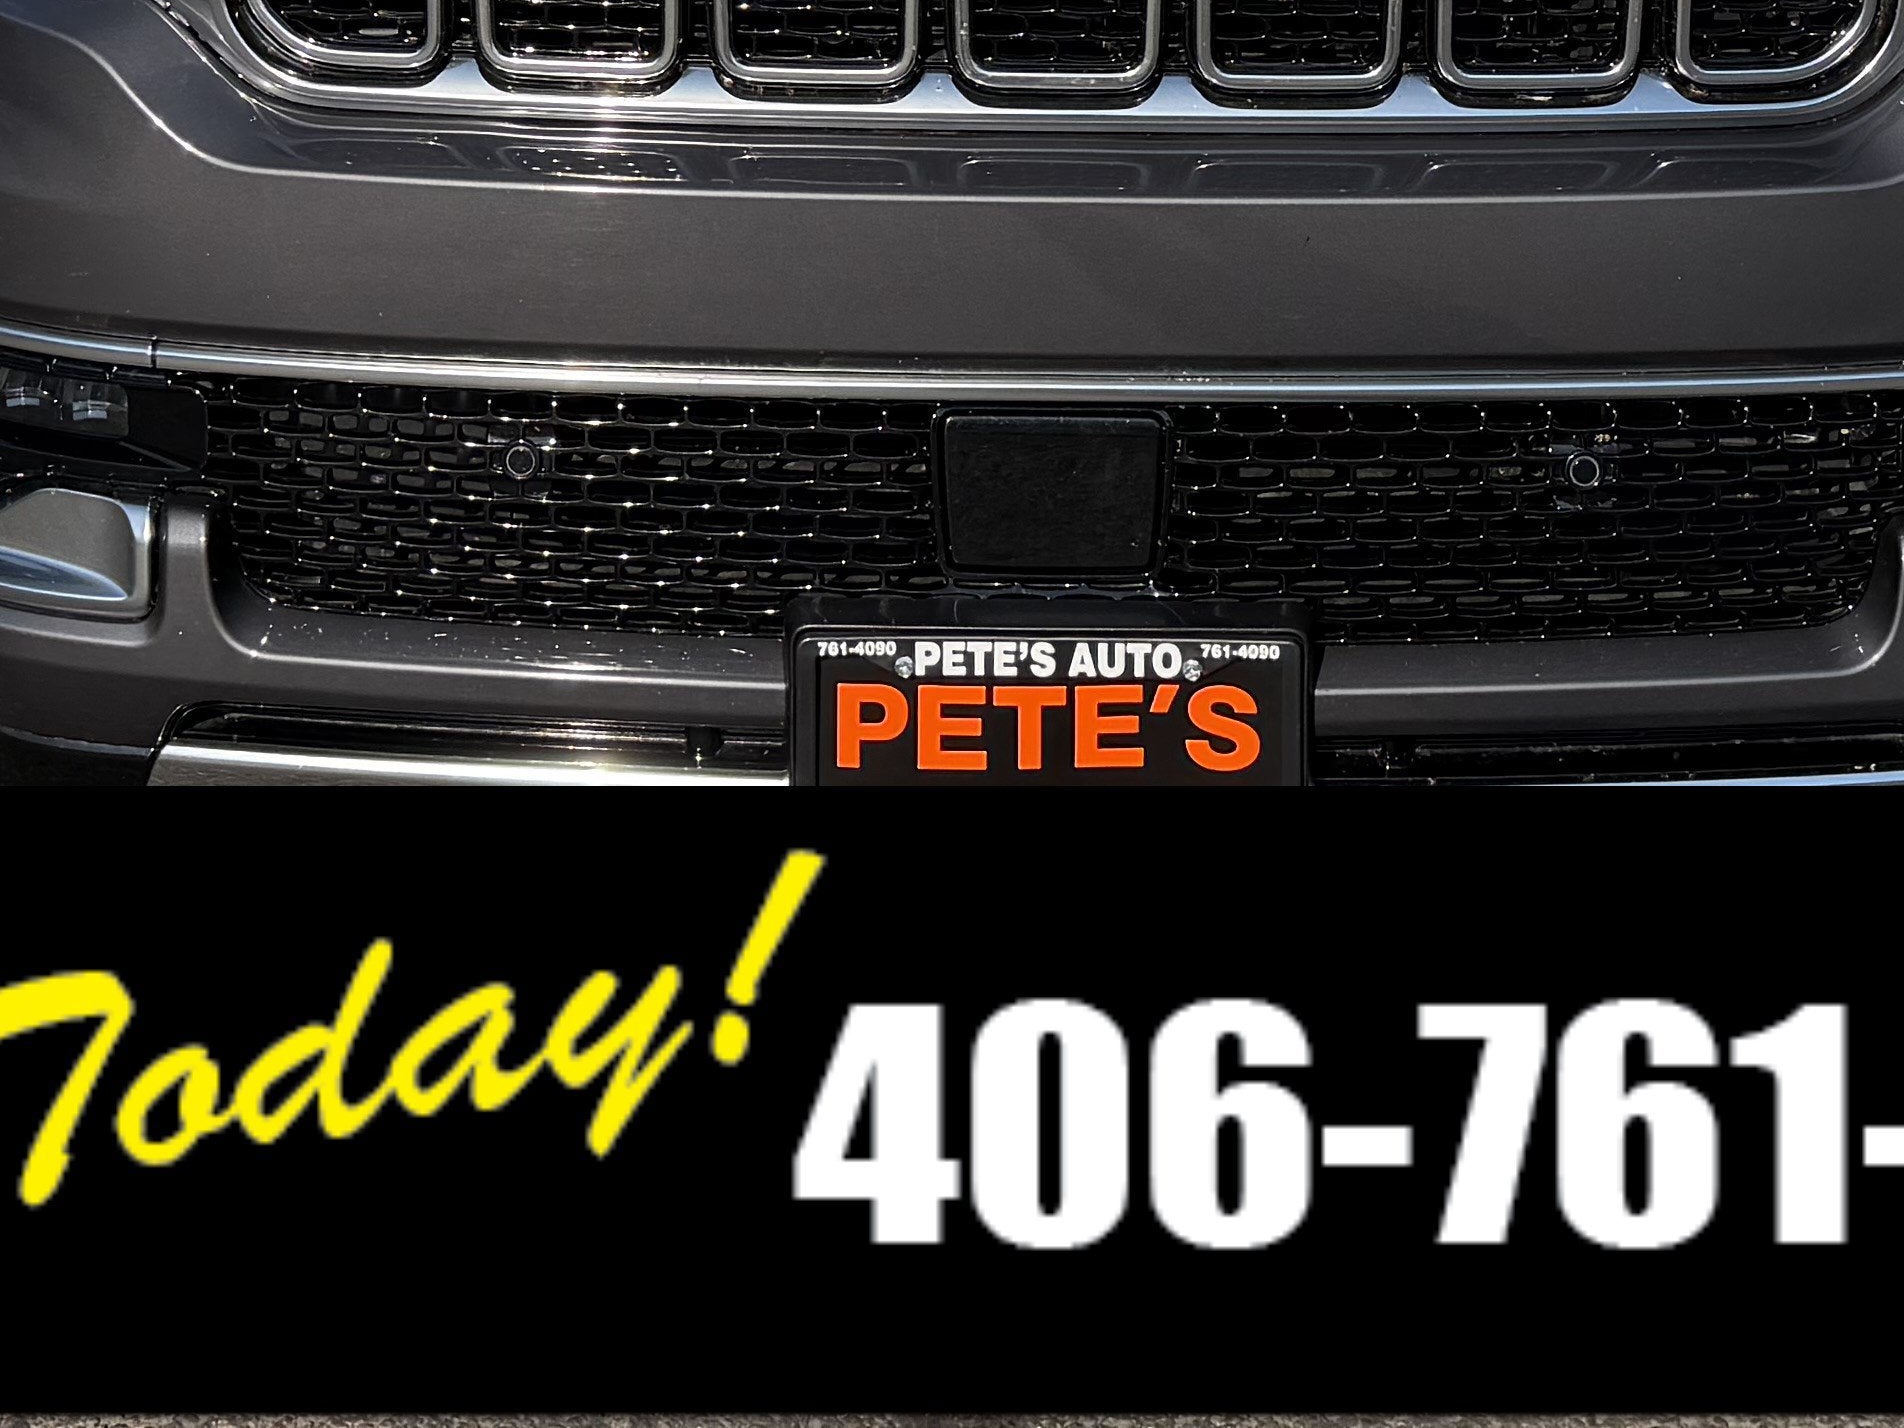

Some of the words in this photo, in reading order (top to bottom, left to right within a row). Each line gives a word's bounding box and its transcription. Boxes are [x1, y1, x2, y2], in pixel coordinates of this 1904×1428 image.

[817, 641, 897, 658] 761-4090
[914, 641, 1057, 678] PETE'S
[1068, 641, 1183, 679] AUTO
[1200, 643, 1281, 661] 761-4090
[836, 683, 1262, 772] PETE'S
